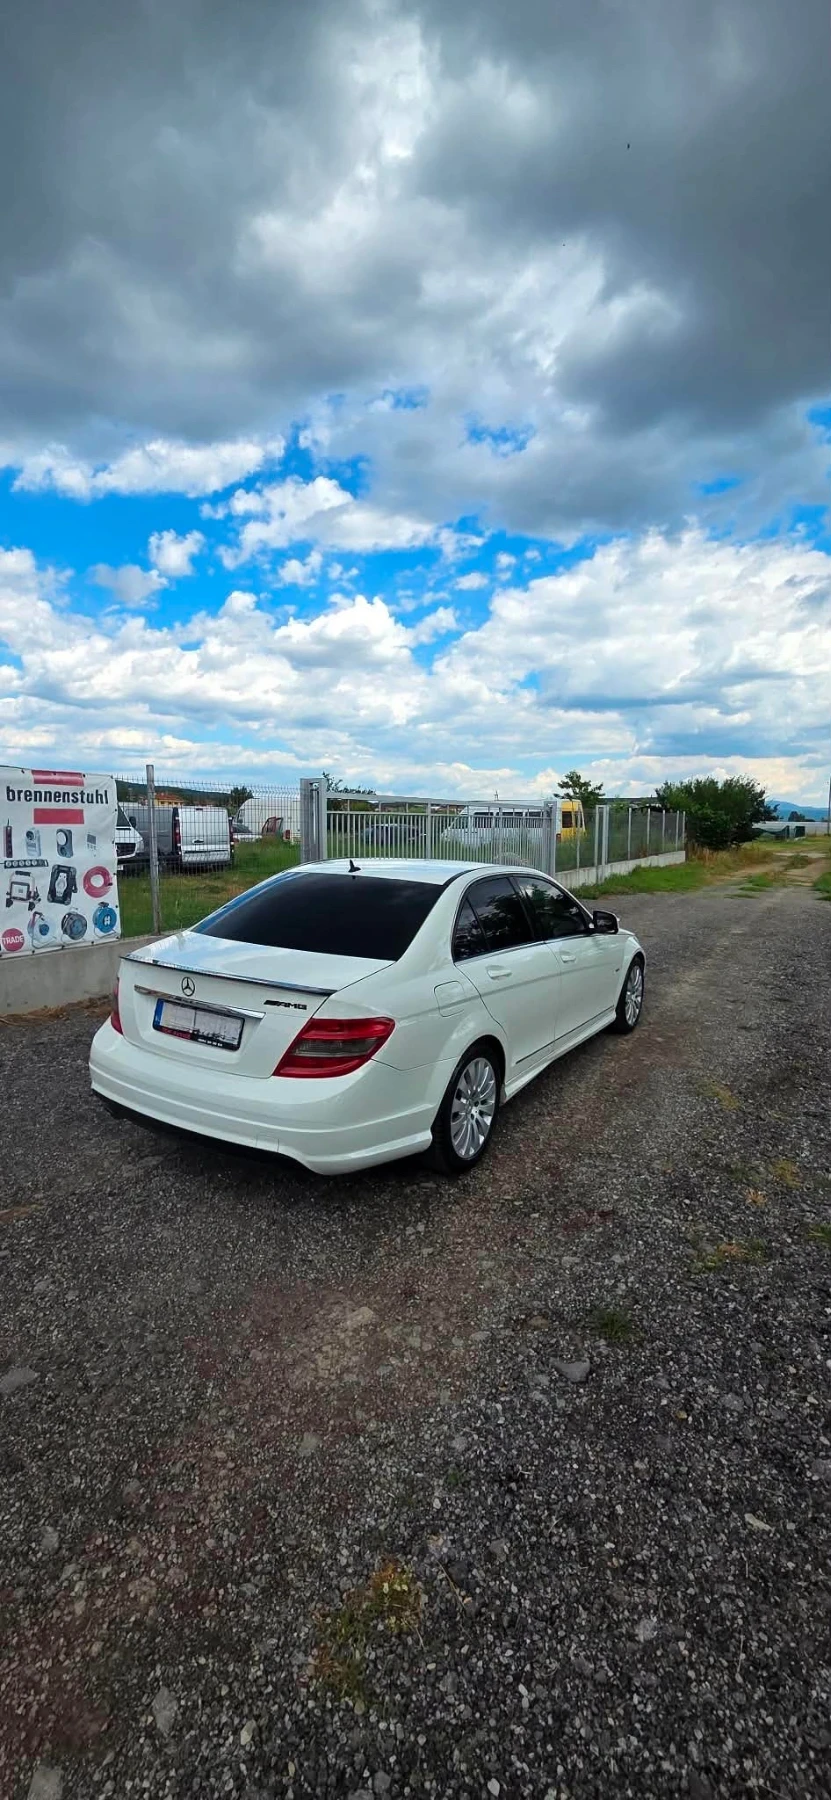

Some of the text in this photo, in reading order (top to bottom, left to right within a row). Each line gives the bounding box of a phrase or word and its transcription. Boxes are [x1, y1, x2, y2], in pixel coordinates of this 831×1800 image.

[6, 786, 109, 804] brennenstuhl
[2, 935, 24, 945] TRADE
[275, 1001, 307, 1010] AMG
